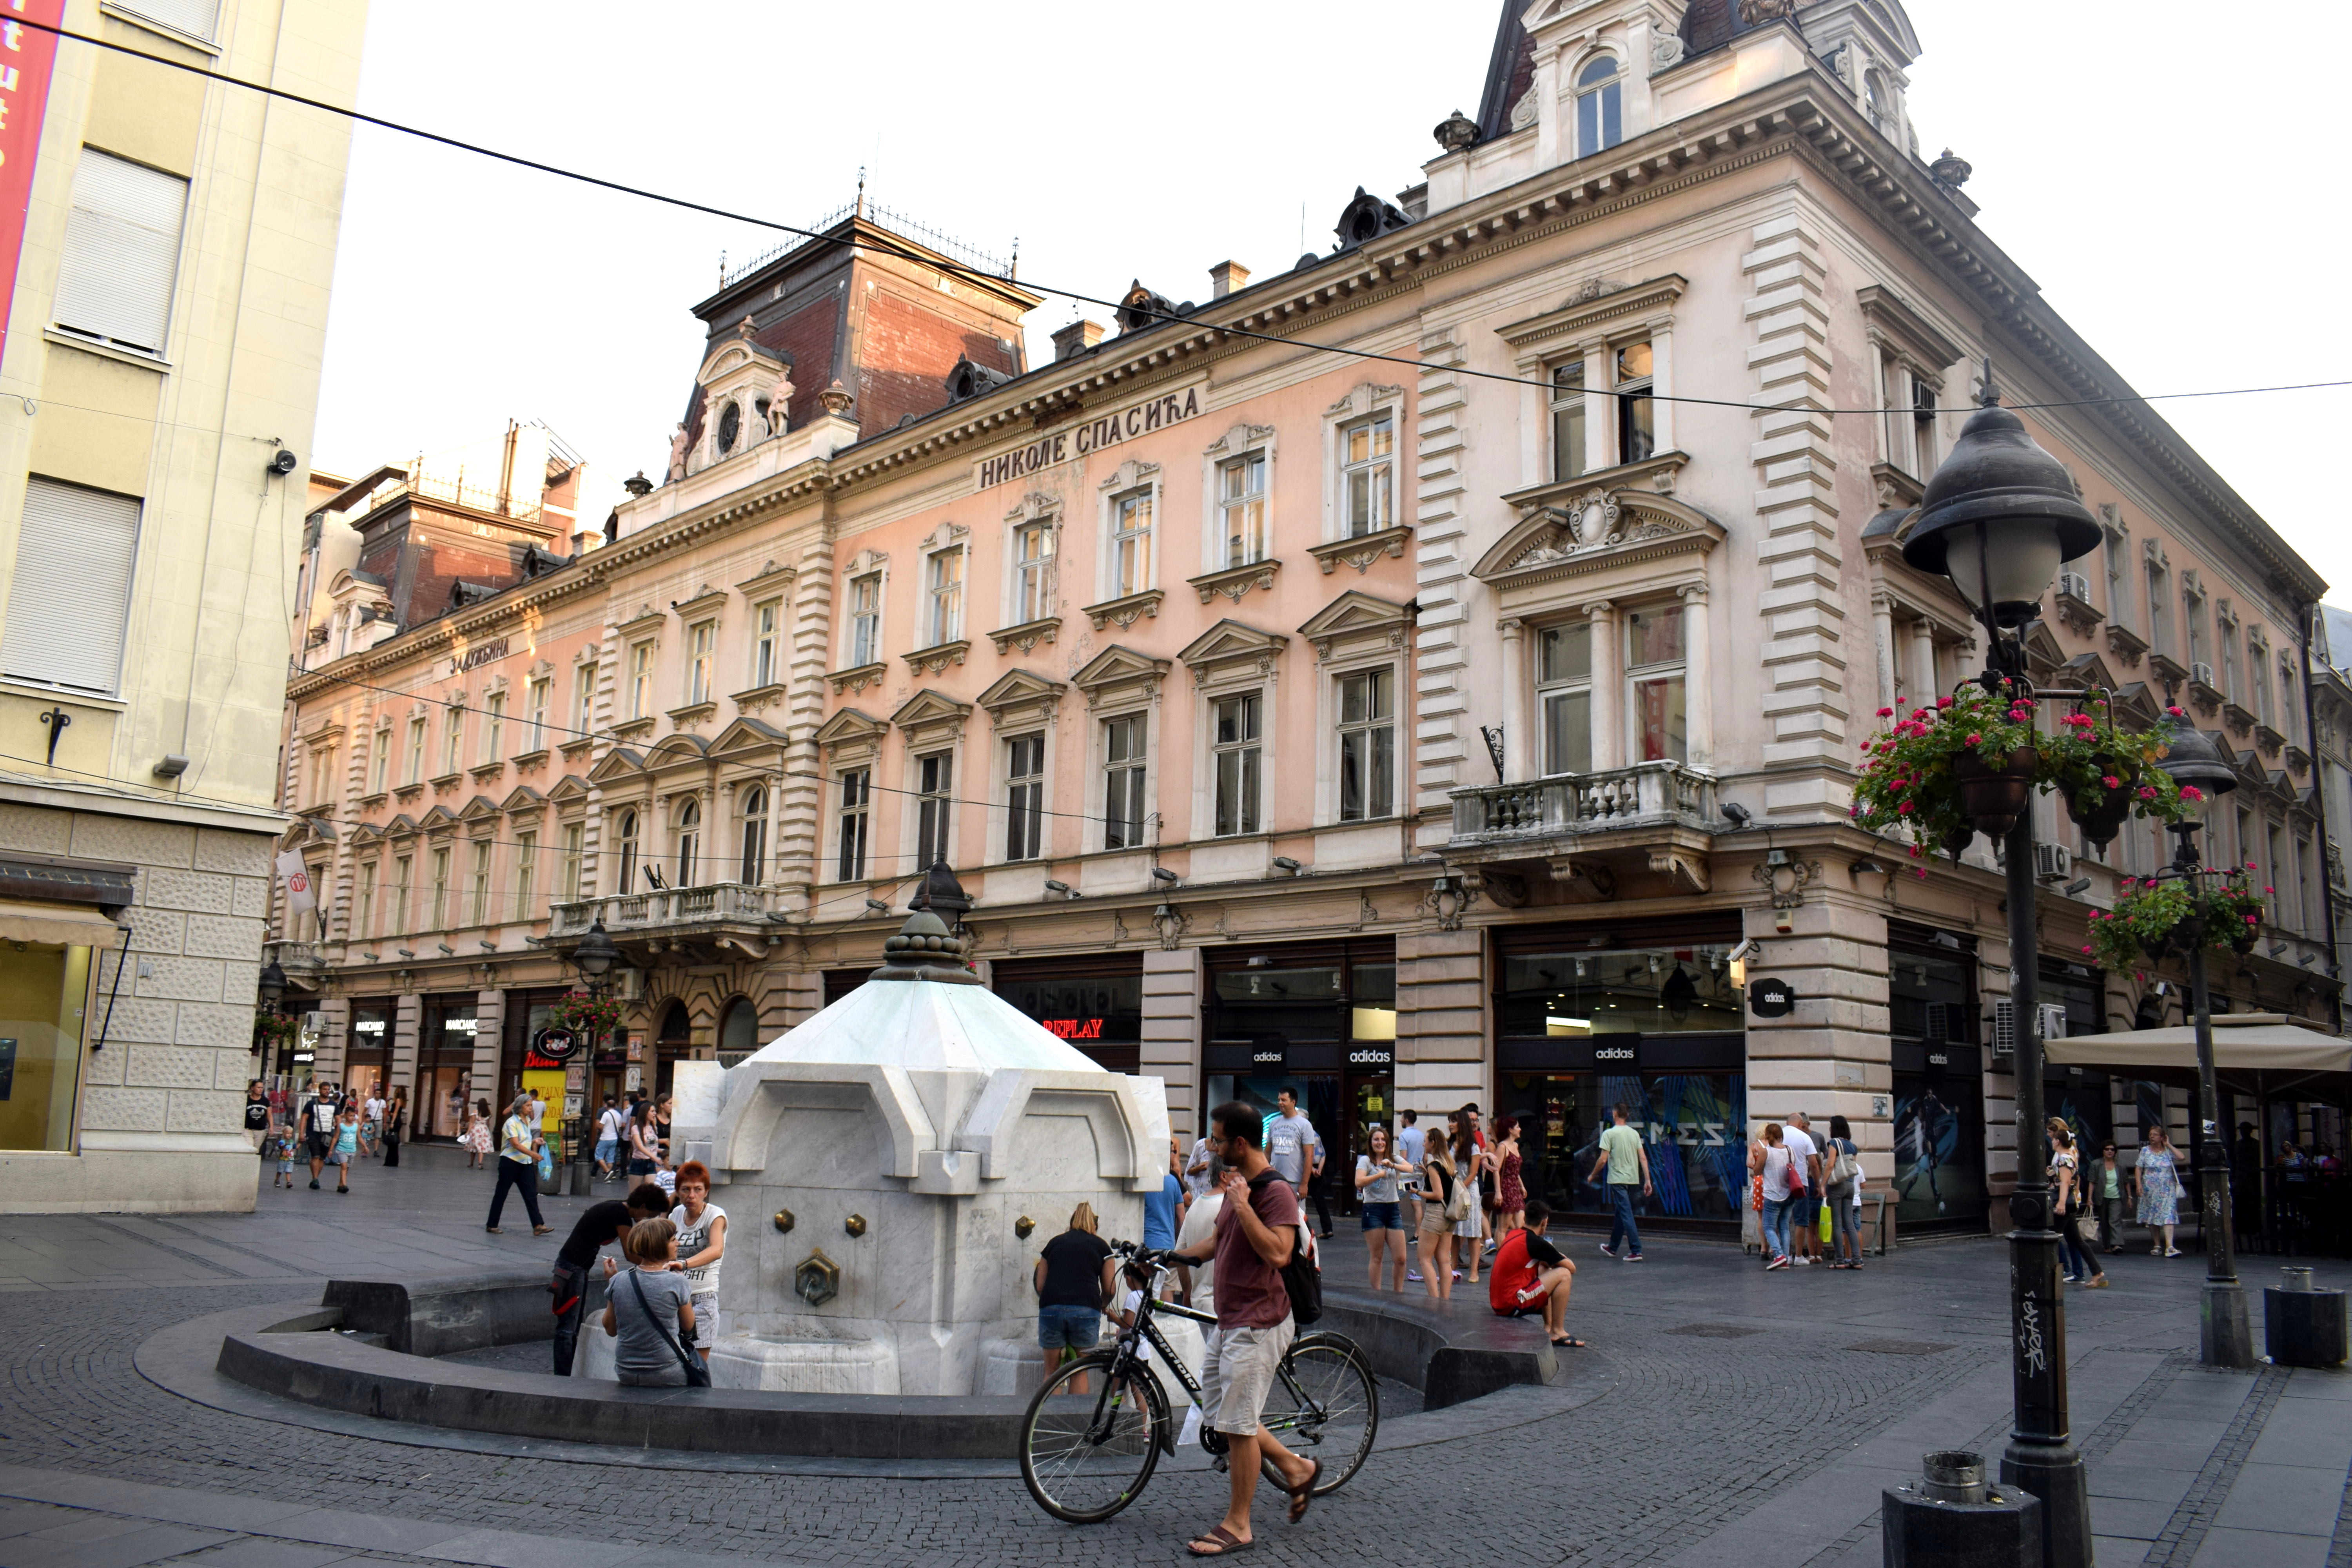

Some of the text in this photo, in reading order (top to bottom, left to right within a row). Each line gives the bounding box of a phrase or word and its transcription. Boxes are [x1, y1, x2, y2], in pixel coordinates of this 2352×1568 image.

[980, 387, 1198, 488] НИКОЛЕ СПАСИЋА
[450, 637, 509, 675] ЗАДУЖБИНА
[1764, 992, 1785, 1003] adidas
[356, 1021, 385, 1031] MARCIANO
[1254, 1052, 1281, 1062] adidas
[1350, 1050, 1390, 1062] adidas
[1596, 1047, 1634, 1059] adidas
[1930, 1053, 1947, 1064] adidas
[1040, 1157, 1069, 1176] 1987
[1149, 1325, 1198, 1390] capriolo
